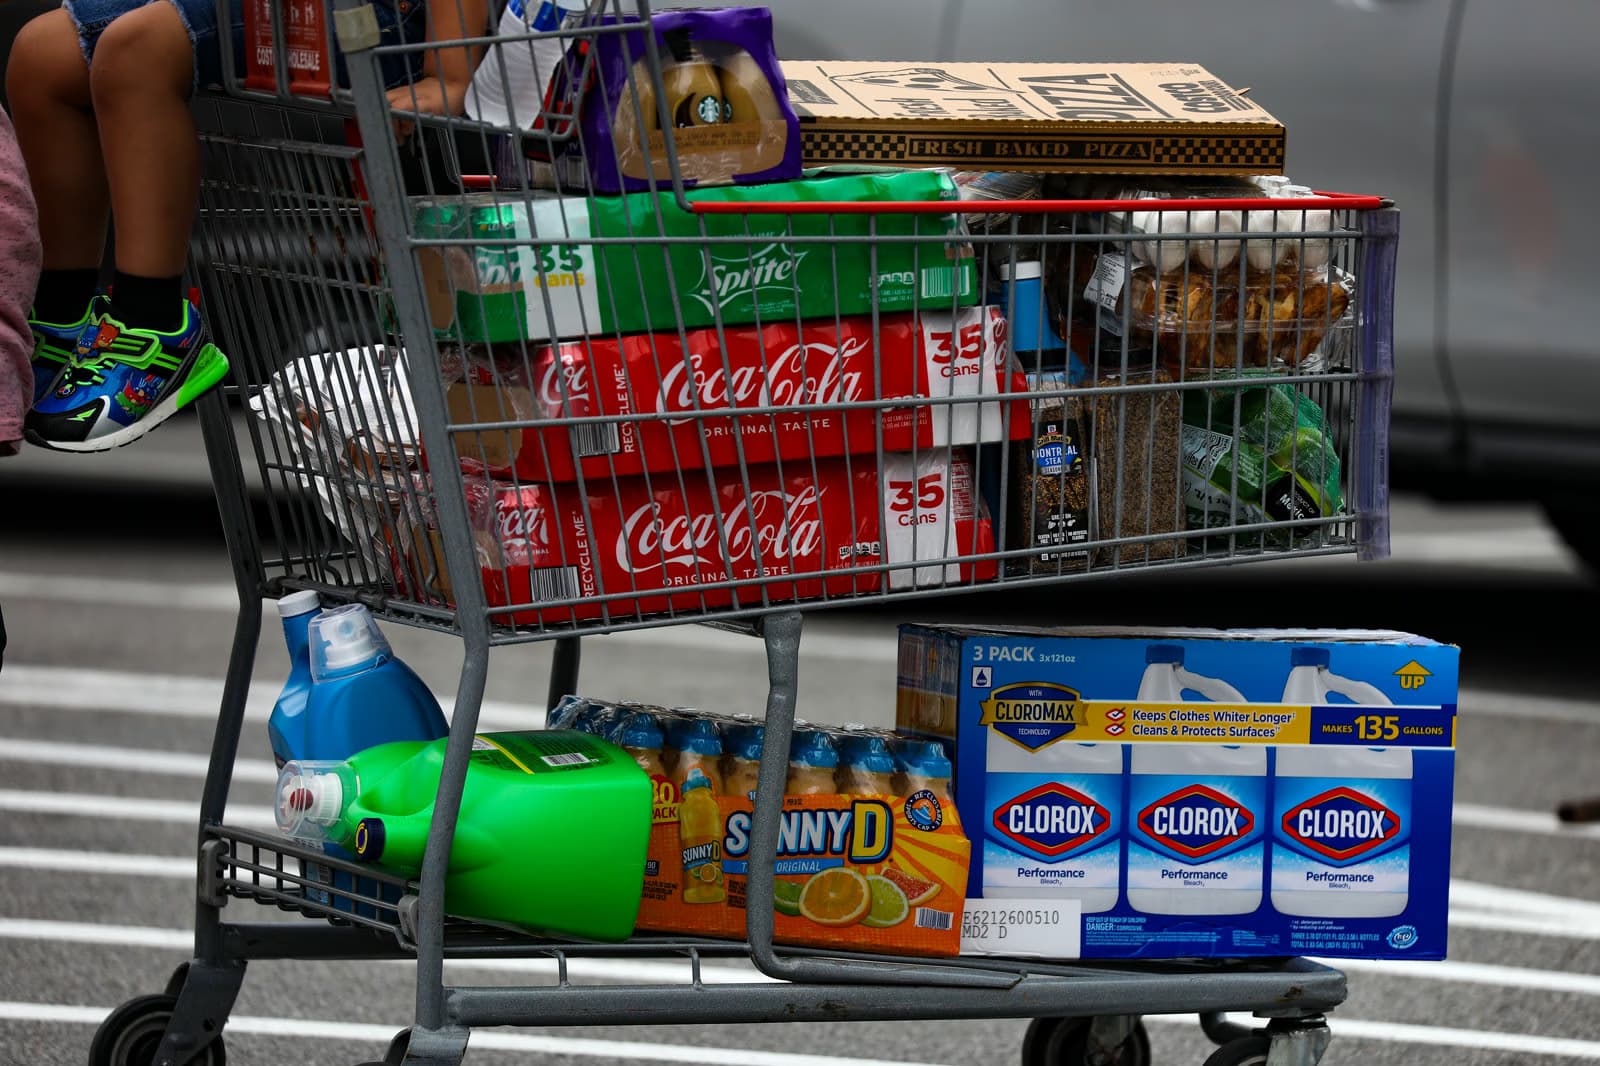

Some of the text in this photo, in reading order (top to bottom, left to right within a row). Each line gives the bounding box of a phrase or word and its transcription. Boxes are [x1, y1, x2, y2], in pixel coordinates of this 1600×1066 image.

[1158, 82, 1231, 113] COSTCO
[911, 140, 1148, 158] FRESH BAKED PIZZA
[701, 256, 792, 297] Sprite
[930, 323, 987, 364] 35
[1044, 456, 1062, 466] STEA
[889, 472, 945, 513] 35
[972, 645, 984, 662] 3
[988, 646, 1036, 662] PACK
[1400, 674, 1425, 689] UP
[1028, 689, 1043, 698] WITH
[1132, 709, 1166, 722] Keeps
[1168, 710, 1210, 722] Clothes
[1213, 710, 1250, 723] Whiter
[1132, 724, 1169, 736] Cleans
[1170, 725, 1178, 736] &
[1181, 725, 1227, 737] Protects
[1322, 714, 1443, 740] MAKES 135 GALLONS
[1009, 804, 1096, 834] CLOROX
[1153, 806, 1239, 836] CLOROX
[1298, 808, 1386, 838] CLOROX
[1017, 867, 1085, 879] Performance
[1161, 868, 1228, 880] Performance
[1306, 871, 1374, 882] Performance
[962, 910, 1060, 925] E6212600510
[998, 925, 1008, 939] D
